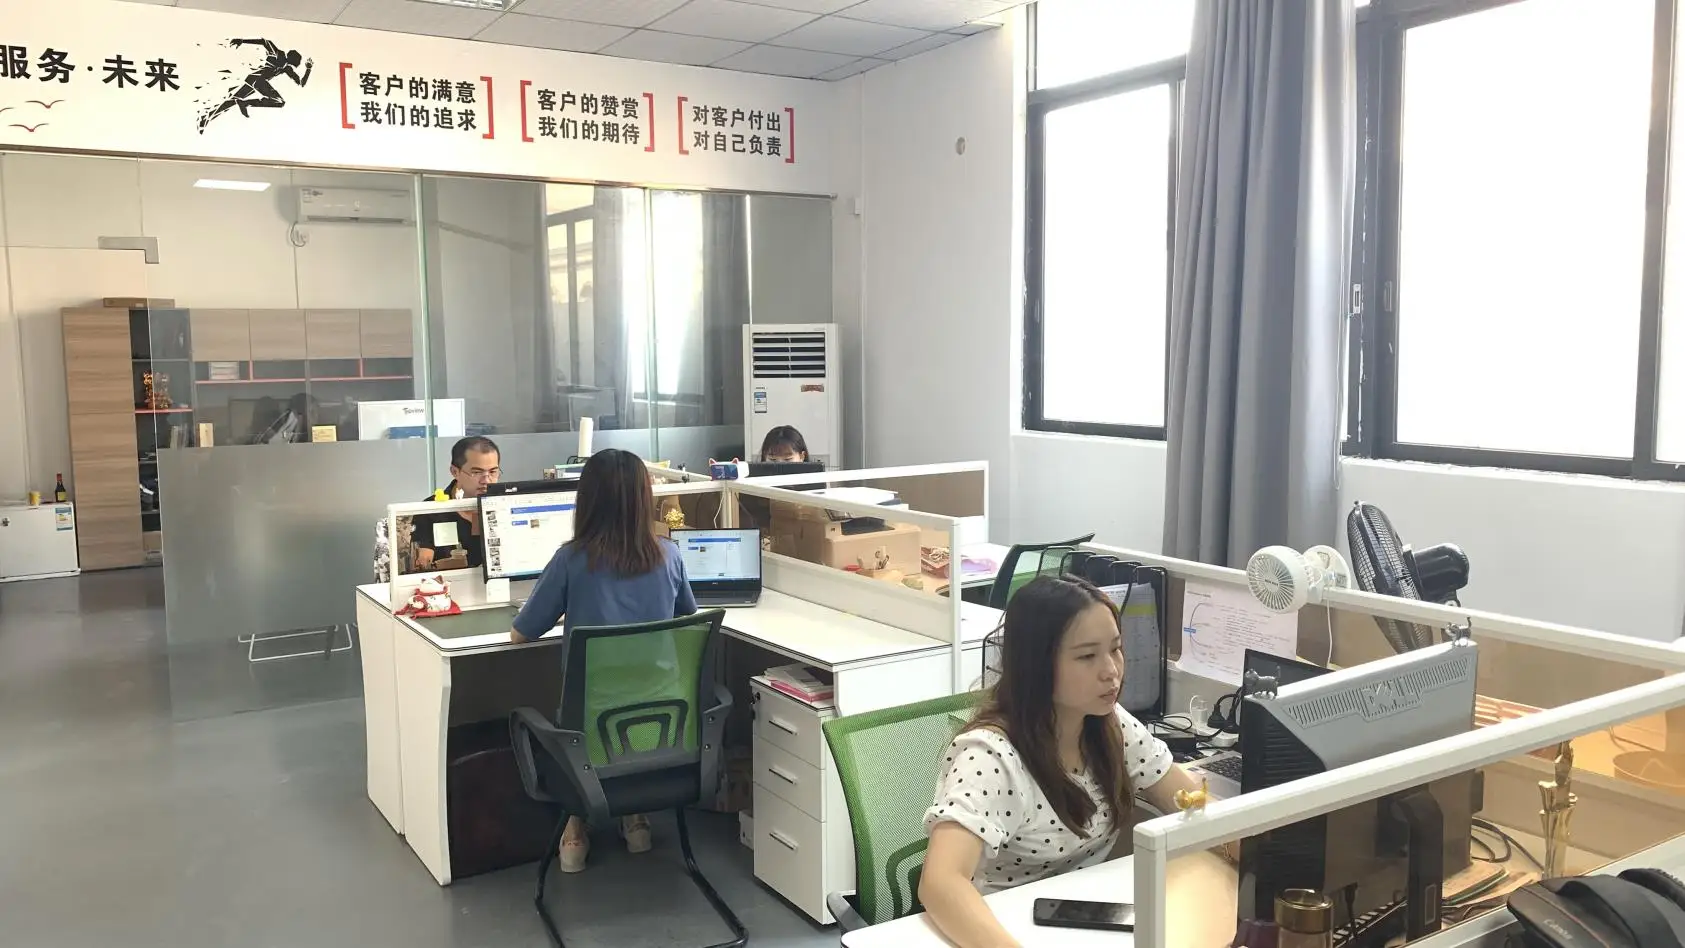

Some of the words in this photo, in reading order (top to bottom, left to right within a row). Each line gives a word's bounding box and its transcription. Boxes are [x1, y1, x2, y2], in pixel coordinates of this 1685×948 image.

[359, 72, 476, 104] 客户的满意
[360, 101, 477, 131] 我们的追求
[537, 89, 639, 119] 客户的赞赏
[692, 104, 781, 132] 对客户付出
[538, 116, 640, 145] 我们的期待
[693, 130, 782, 157] 对自己负责
